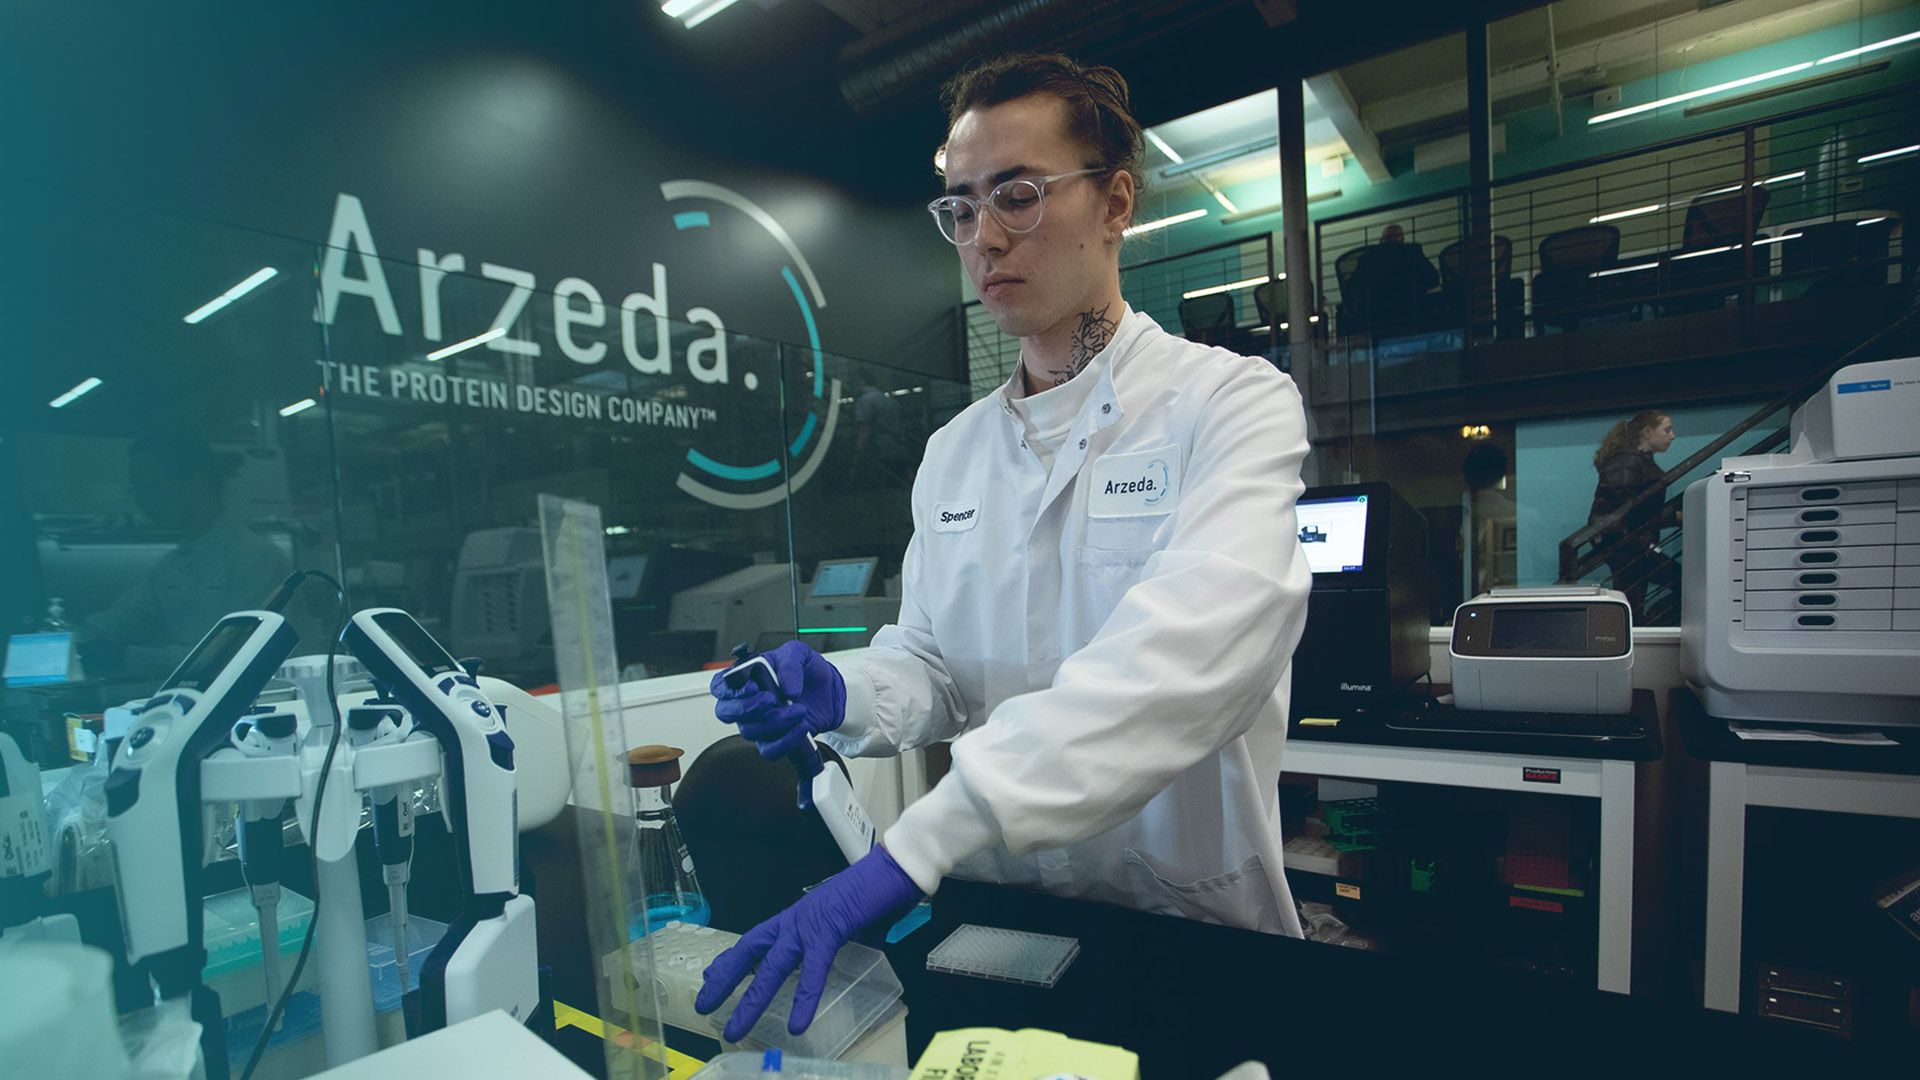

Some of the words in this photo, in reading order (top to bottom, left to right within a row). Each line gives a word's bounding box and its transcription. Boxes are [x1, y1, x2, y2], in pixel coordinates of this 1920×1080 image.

[313, 193, 758, 391] Arzeda.
[315, 359, 381, 397] THE
[390, 368, 508, 410] PROTEIN
[516, 384, 601, 420] DESIGN
[1104, 476, 1157, 495] Arzeda.
[940, 507, 976, 524] Spencer
